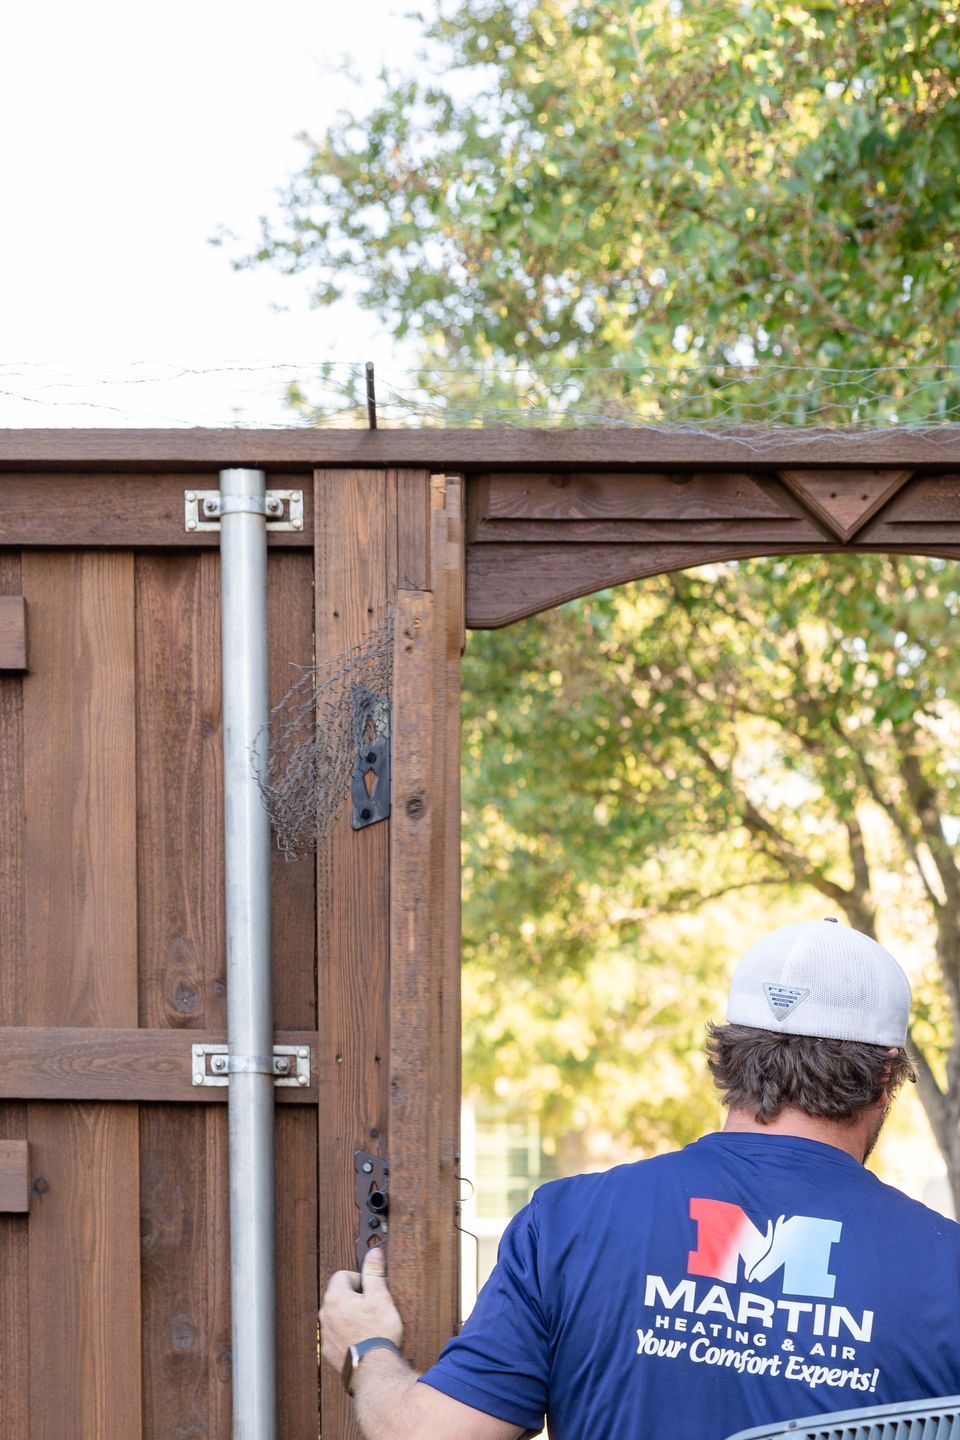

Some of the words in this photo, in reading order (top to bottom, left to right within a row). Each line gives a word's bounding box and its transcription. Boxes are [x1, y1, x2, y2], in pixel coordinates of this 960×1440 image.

[644, 1274, 874, 1343] MARTIN
[654, 1314, 767, 1348] HEATING
[780, 1338, 796, 1352] &
[809, 1342, 857, 1361] AIR
[635, 1328, 688, 1356] Your
[689, 1337, 783, 1377] Comfort
[784, 1355, 880, 1393] Experts!
